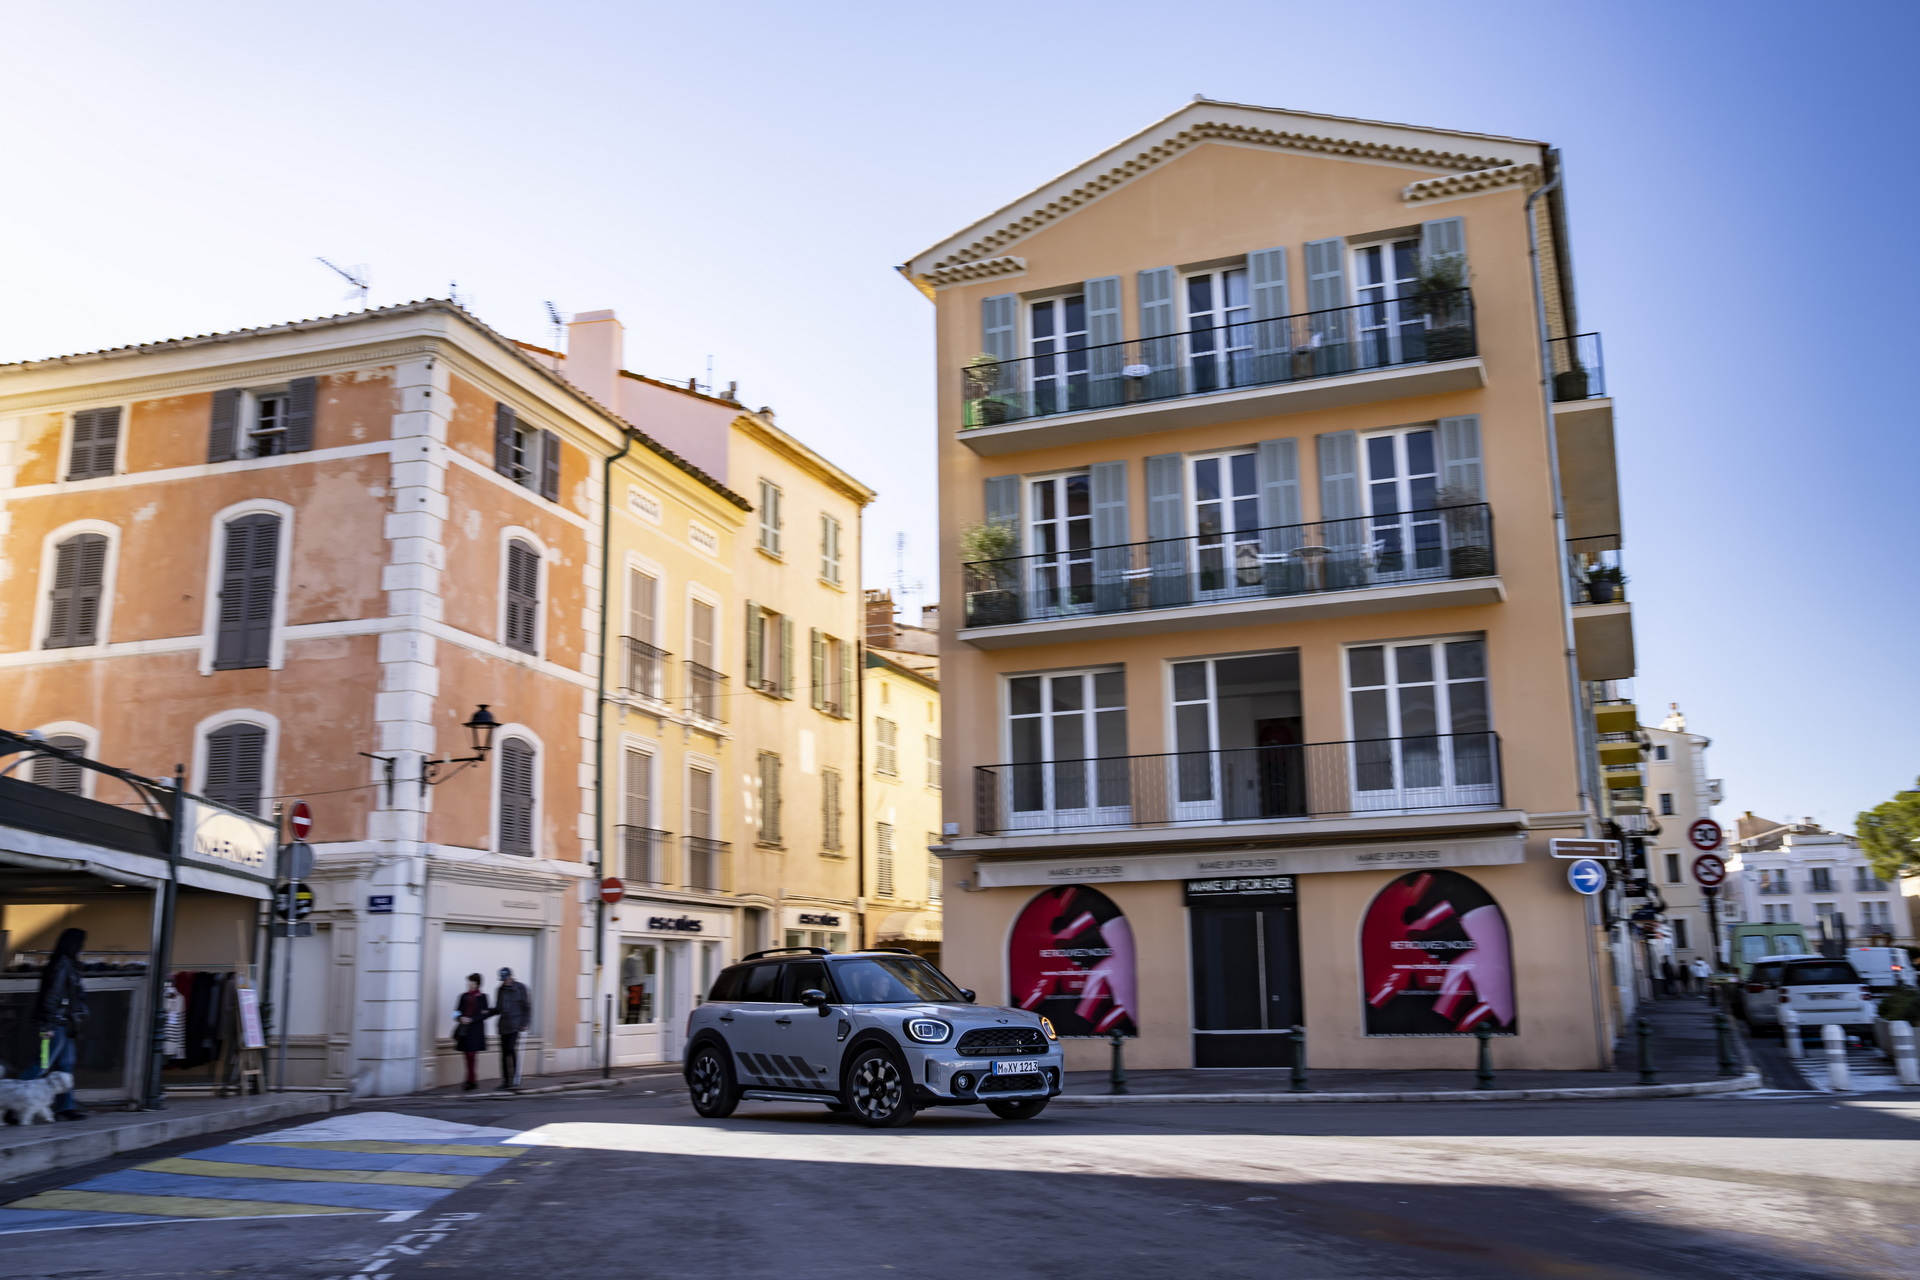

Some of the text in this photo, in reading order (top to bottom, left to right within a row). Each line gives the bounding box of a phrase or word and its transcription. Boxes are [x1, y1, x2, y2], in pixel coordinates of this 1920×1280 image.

[1188, 880, 1222, 892] MAKE
[1239, 879, 1263, 890] FOR
[1263, 877, 1293, 889] EVER
[998, 1062, 1038, 1073] M XY 1213
